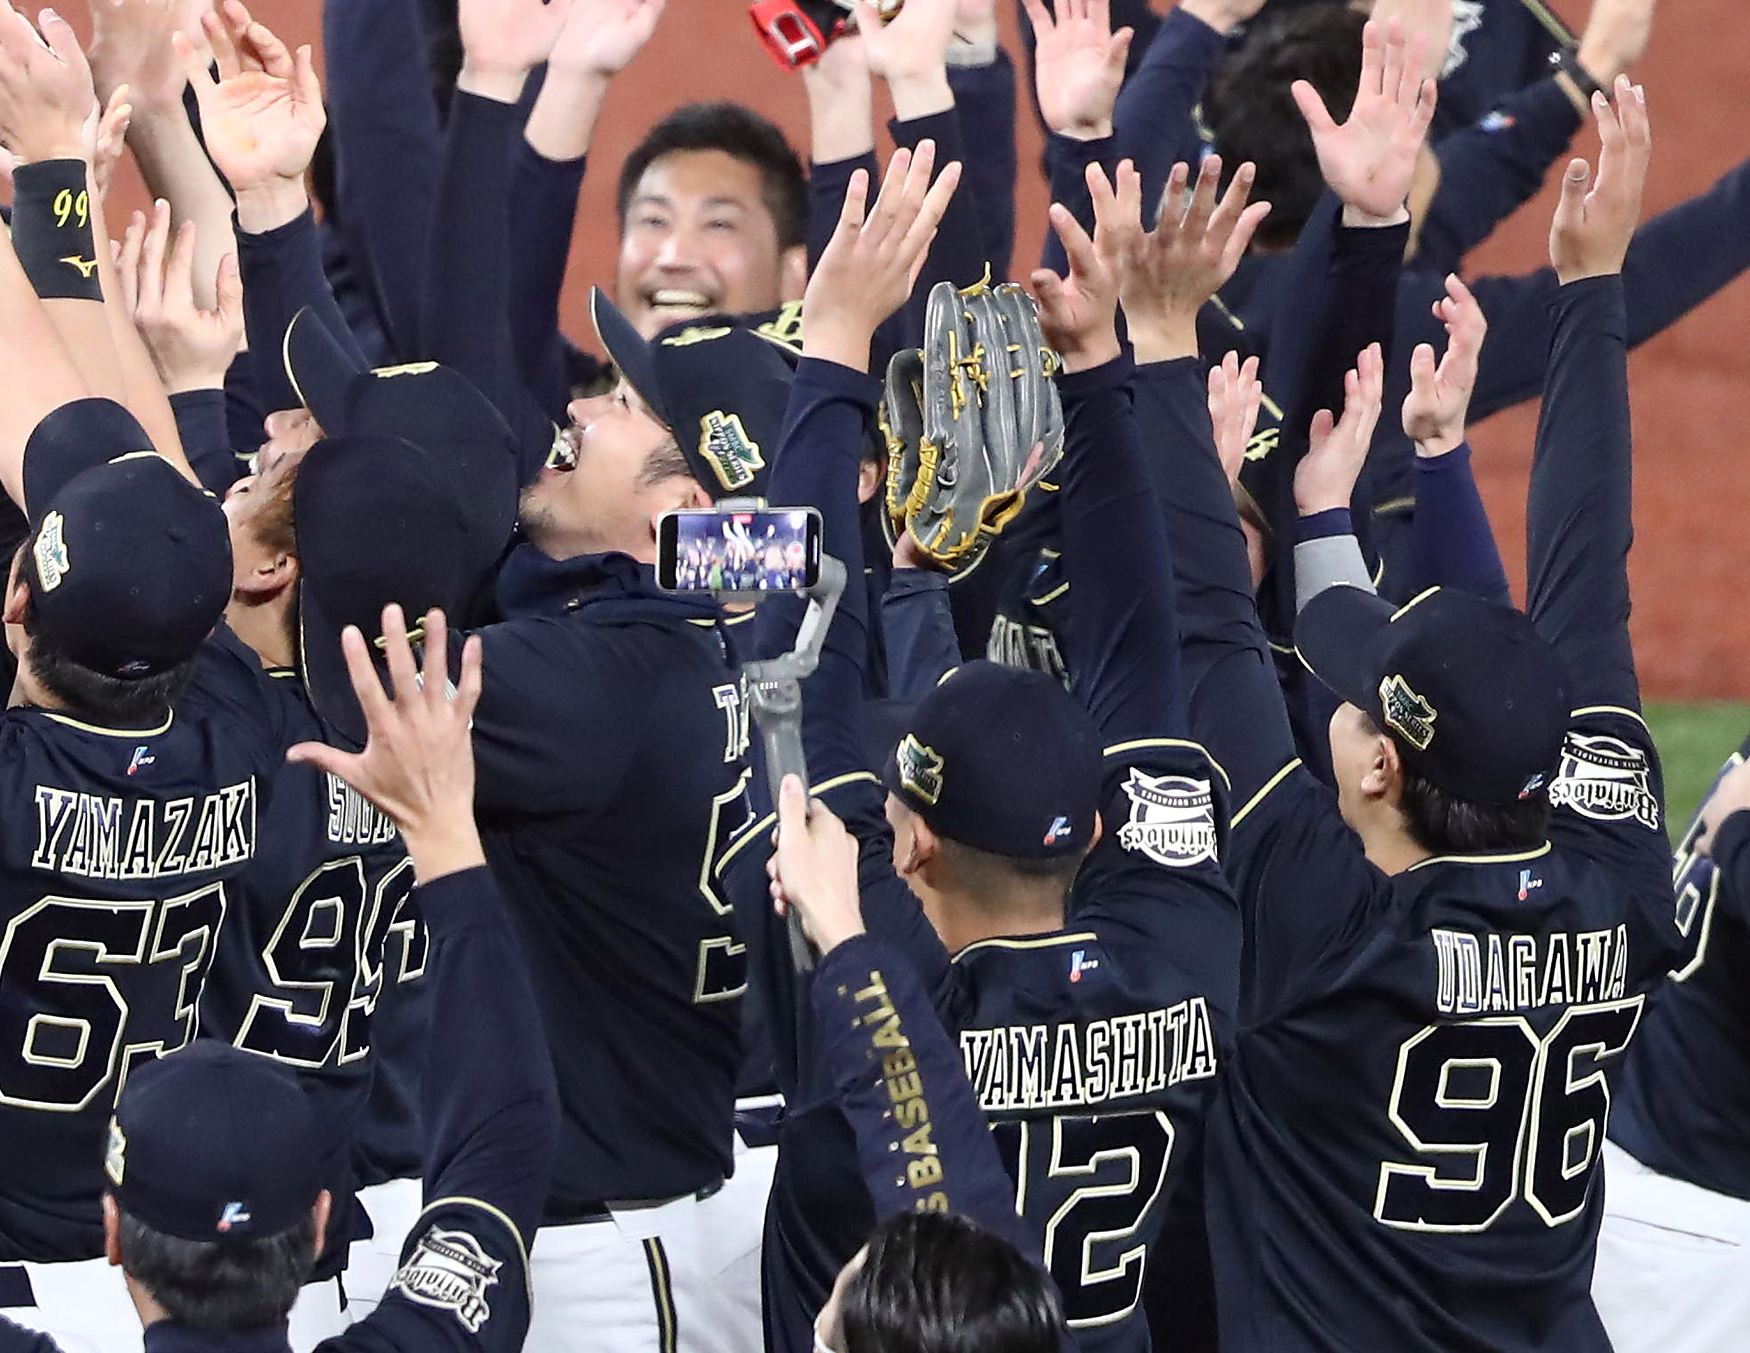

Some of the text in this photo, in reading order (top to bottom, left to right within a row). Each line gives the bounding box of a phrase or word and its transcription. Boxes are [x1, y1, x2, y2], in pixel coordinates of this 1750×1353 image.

[53, 188, 88, 228] 99
[31, 774, 255, 880] YAMAZAK
[1431, 924, 1628, 1014] UDAGAWA
[853, 969, 944, 1190] BASEBALL
[961, 997, 1216, 1112] YAMASHITA
[1373, 994, 1646, 1234] 96
